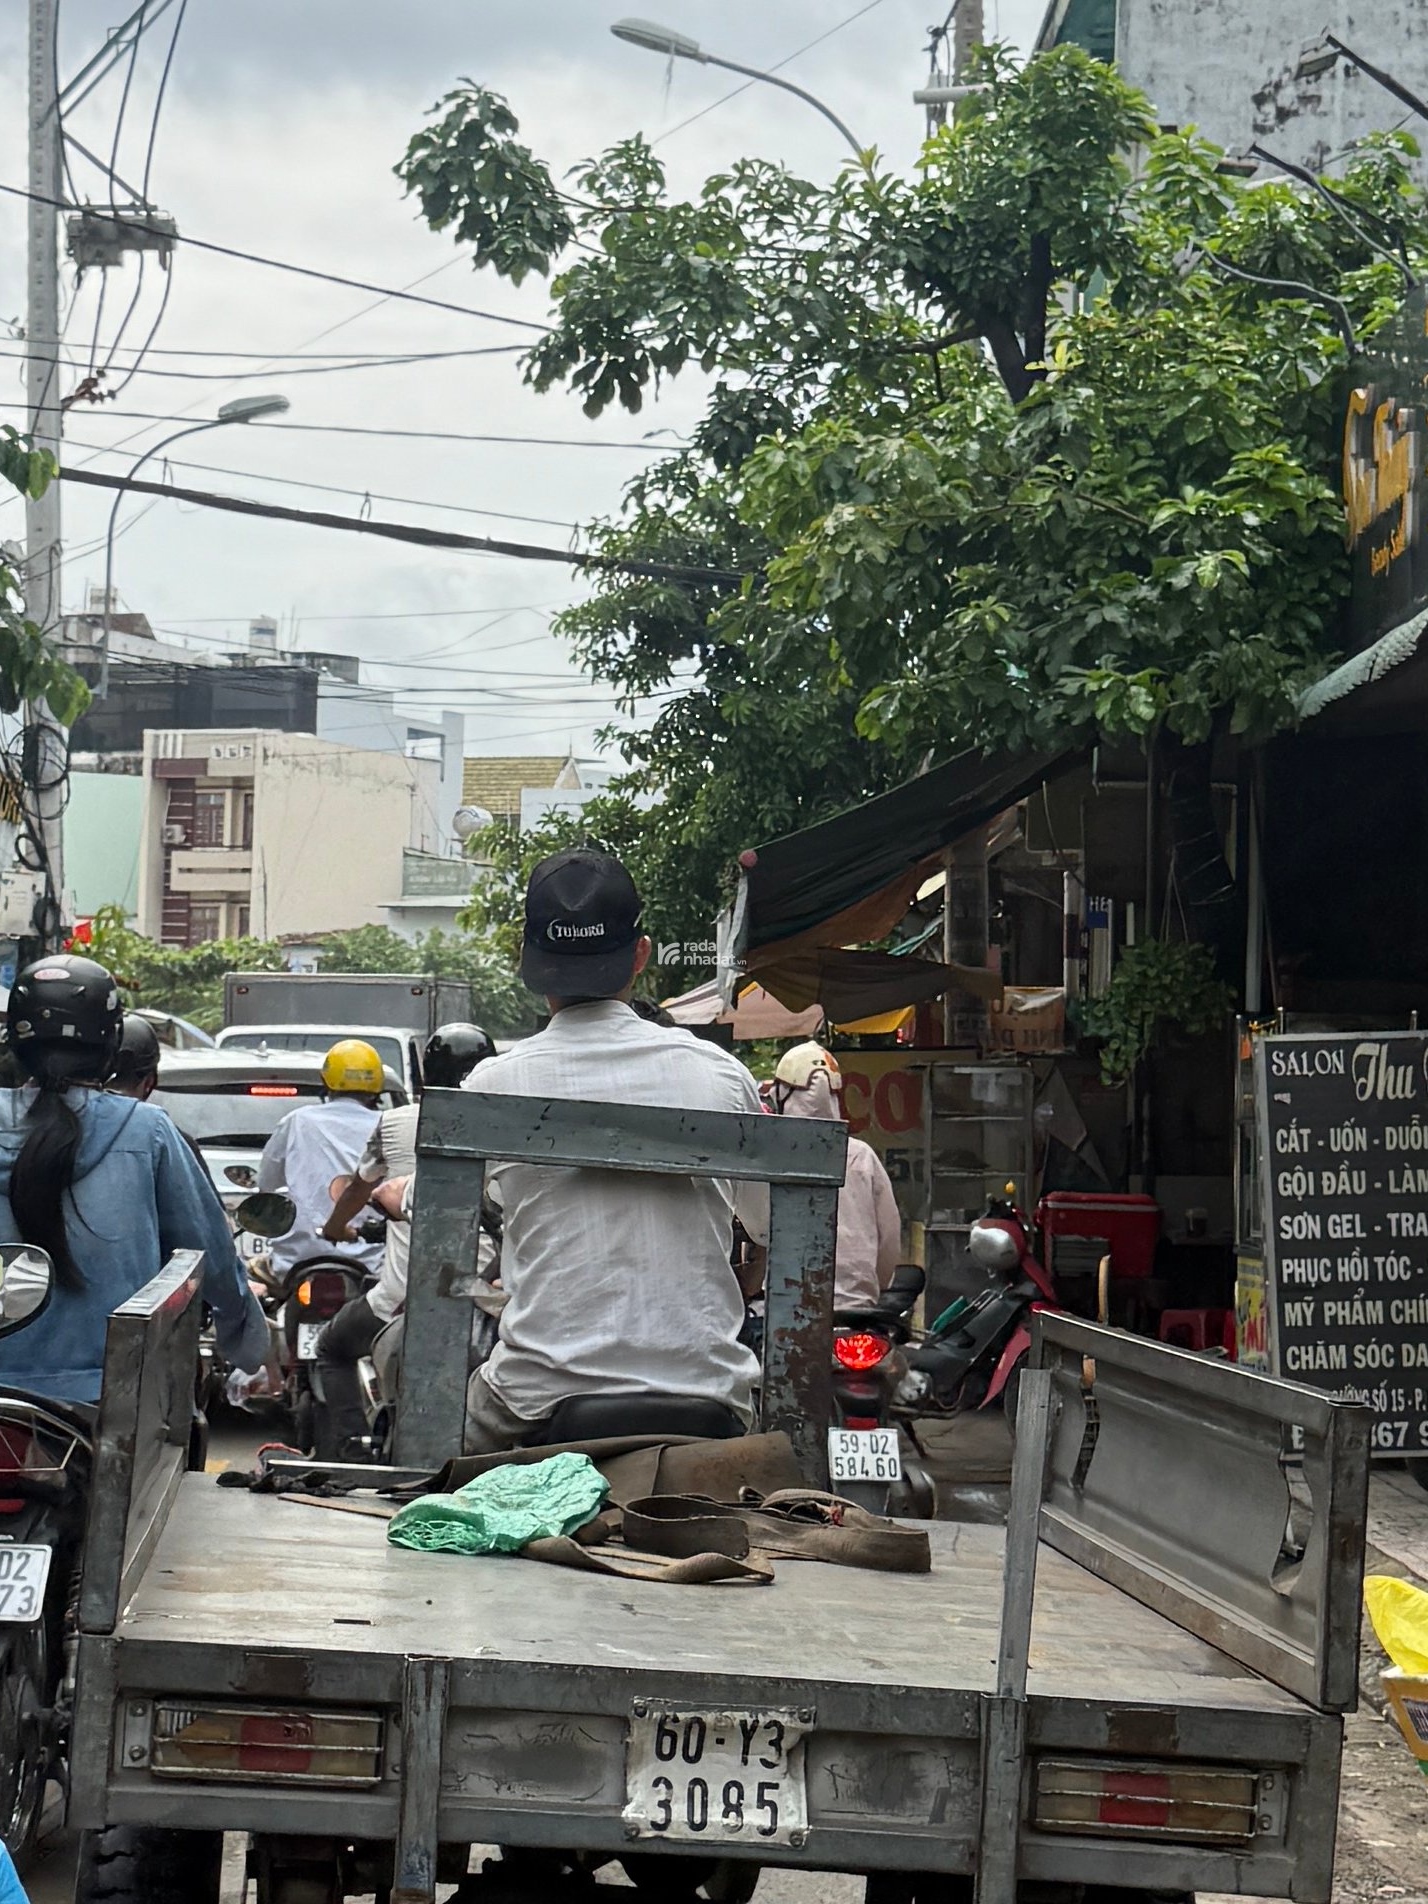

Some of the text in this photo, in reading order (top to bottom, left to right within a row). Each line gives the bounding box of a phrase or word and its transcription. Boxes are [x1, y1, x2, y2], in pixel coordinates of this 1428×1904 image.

[1271, 1049, 1345, 1080] SALON
[1351, 1041, 1417, 1102] Thu
[1276, 1117, 1310, 1154] CẮT
[1329, 1116, 1368, 1152] UỐN
[1277, 1165, 1315, 1200] GỘI
[1321, 1161, 1367, 1196] ĐẦU
[1279, 1211, 1322, 1241] SƠN
[1327, 1211, 1367, 1240] GEL
[1281, 1255, 1332, 1290] PHỤC
[1336, 1246, 1370, 1282] HỒI
[1373, 1249, 1411, 1281] TÓC
[1284, 1294, 1315, 1328] MỸ
[1323, 1286, 1383, 1326] PHẨM
[1285, 1339, 1348, 1371] CHĂM
[1352, 1334, 1395, 1369] SÓC
[1371, 1379, 1388, 1413] SỐ
[1391, 1387, 1405, 1412] 15
[654, 1714, 786, 1770] 60-Y3
[650, 1776, 781, 1837] 3085
